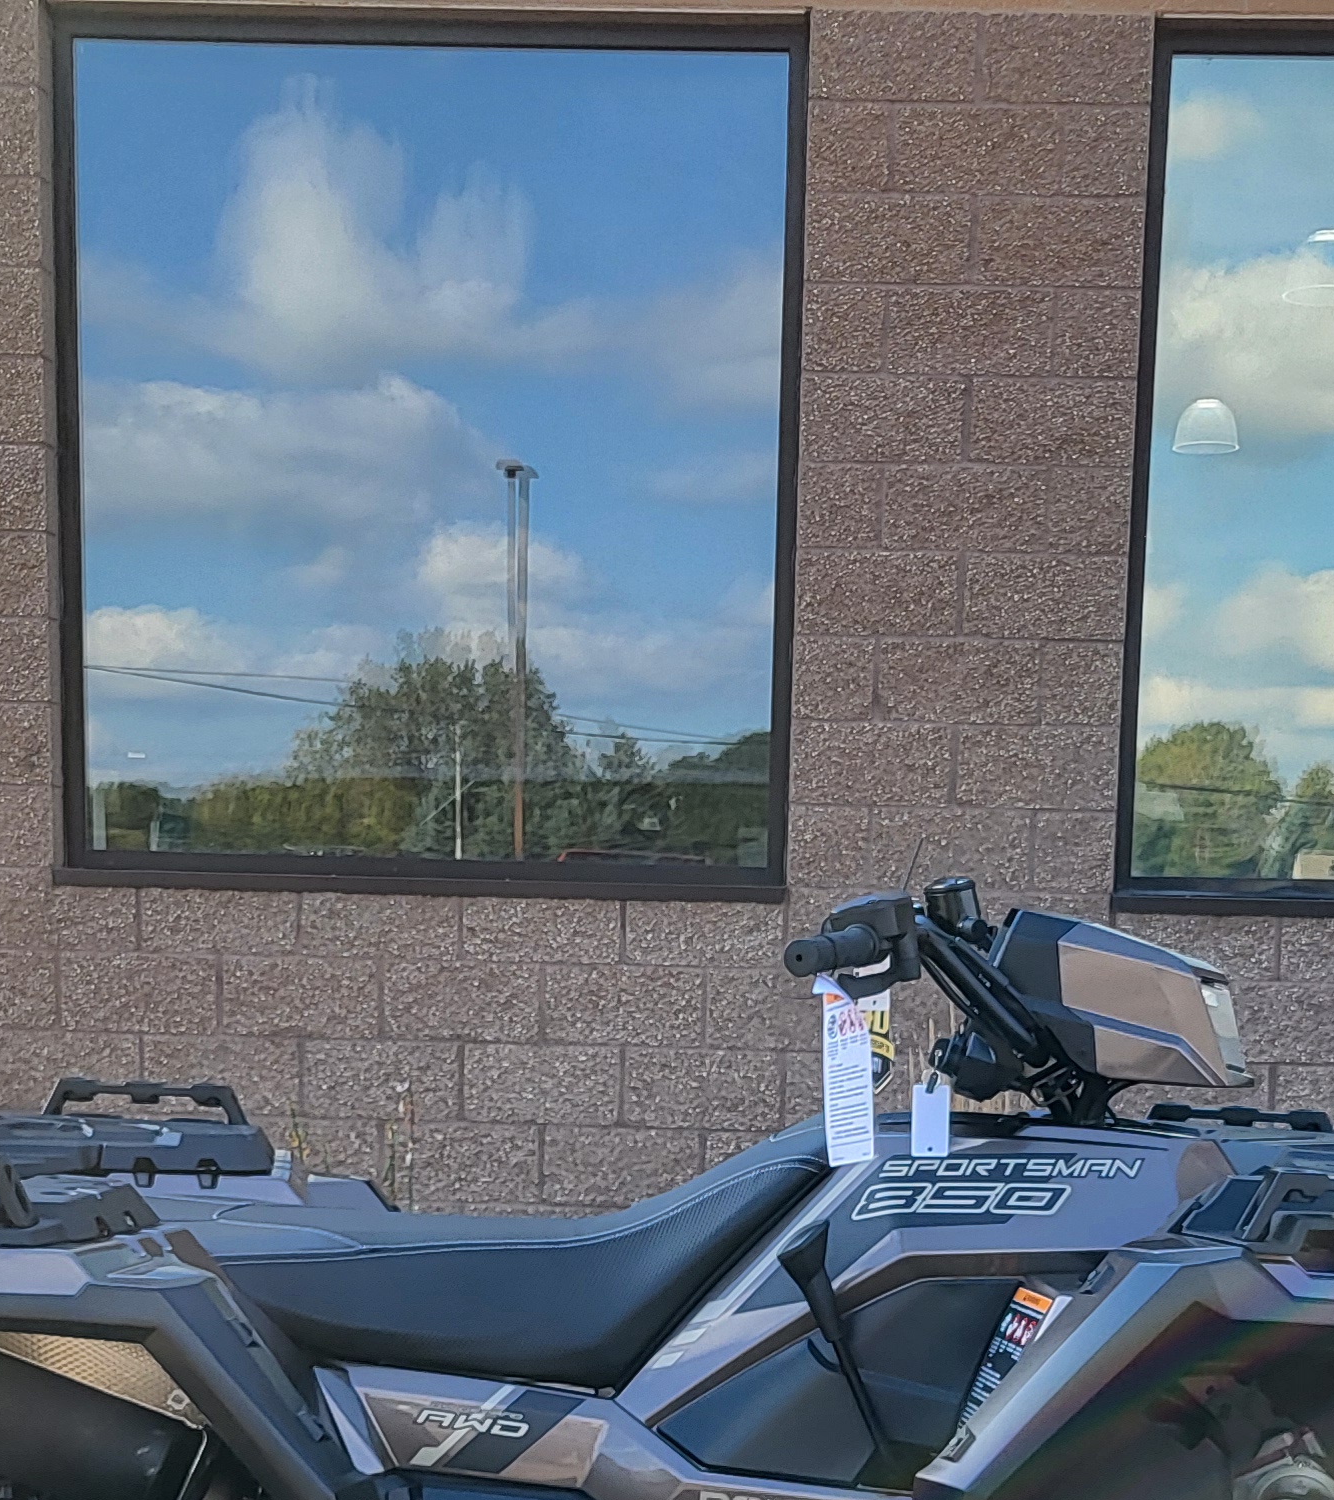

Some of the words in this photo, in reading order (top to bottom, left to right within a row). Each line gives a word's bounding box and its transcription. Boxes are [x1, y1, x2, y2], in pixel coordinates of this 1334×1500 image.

[878, 1157, 1143, 1179] SPORTSMAN
[851, 1181, 1072, 1220] 850
[416, 1408, 530, 1438] AWD
